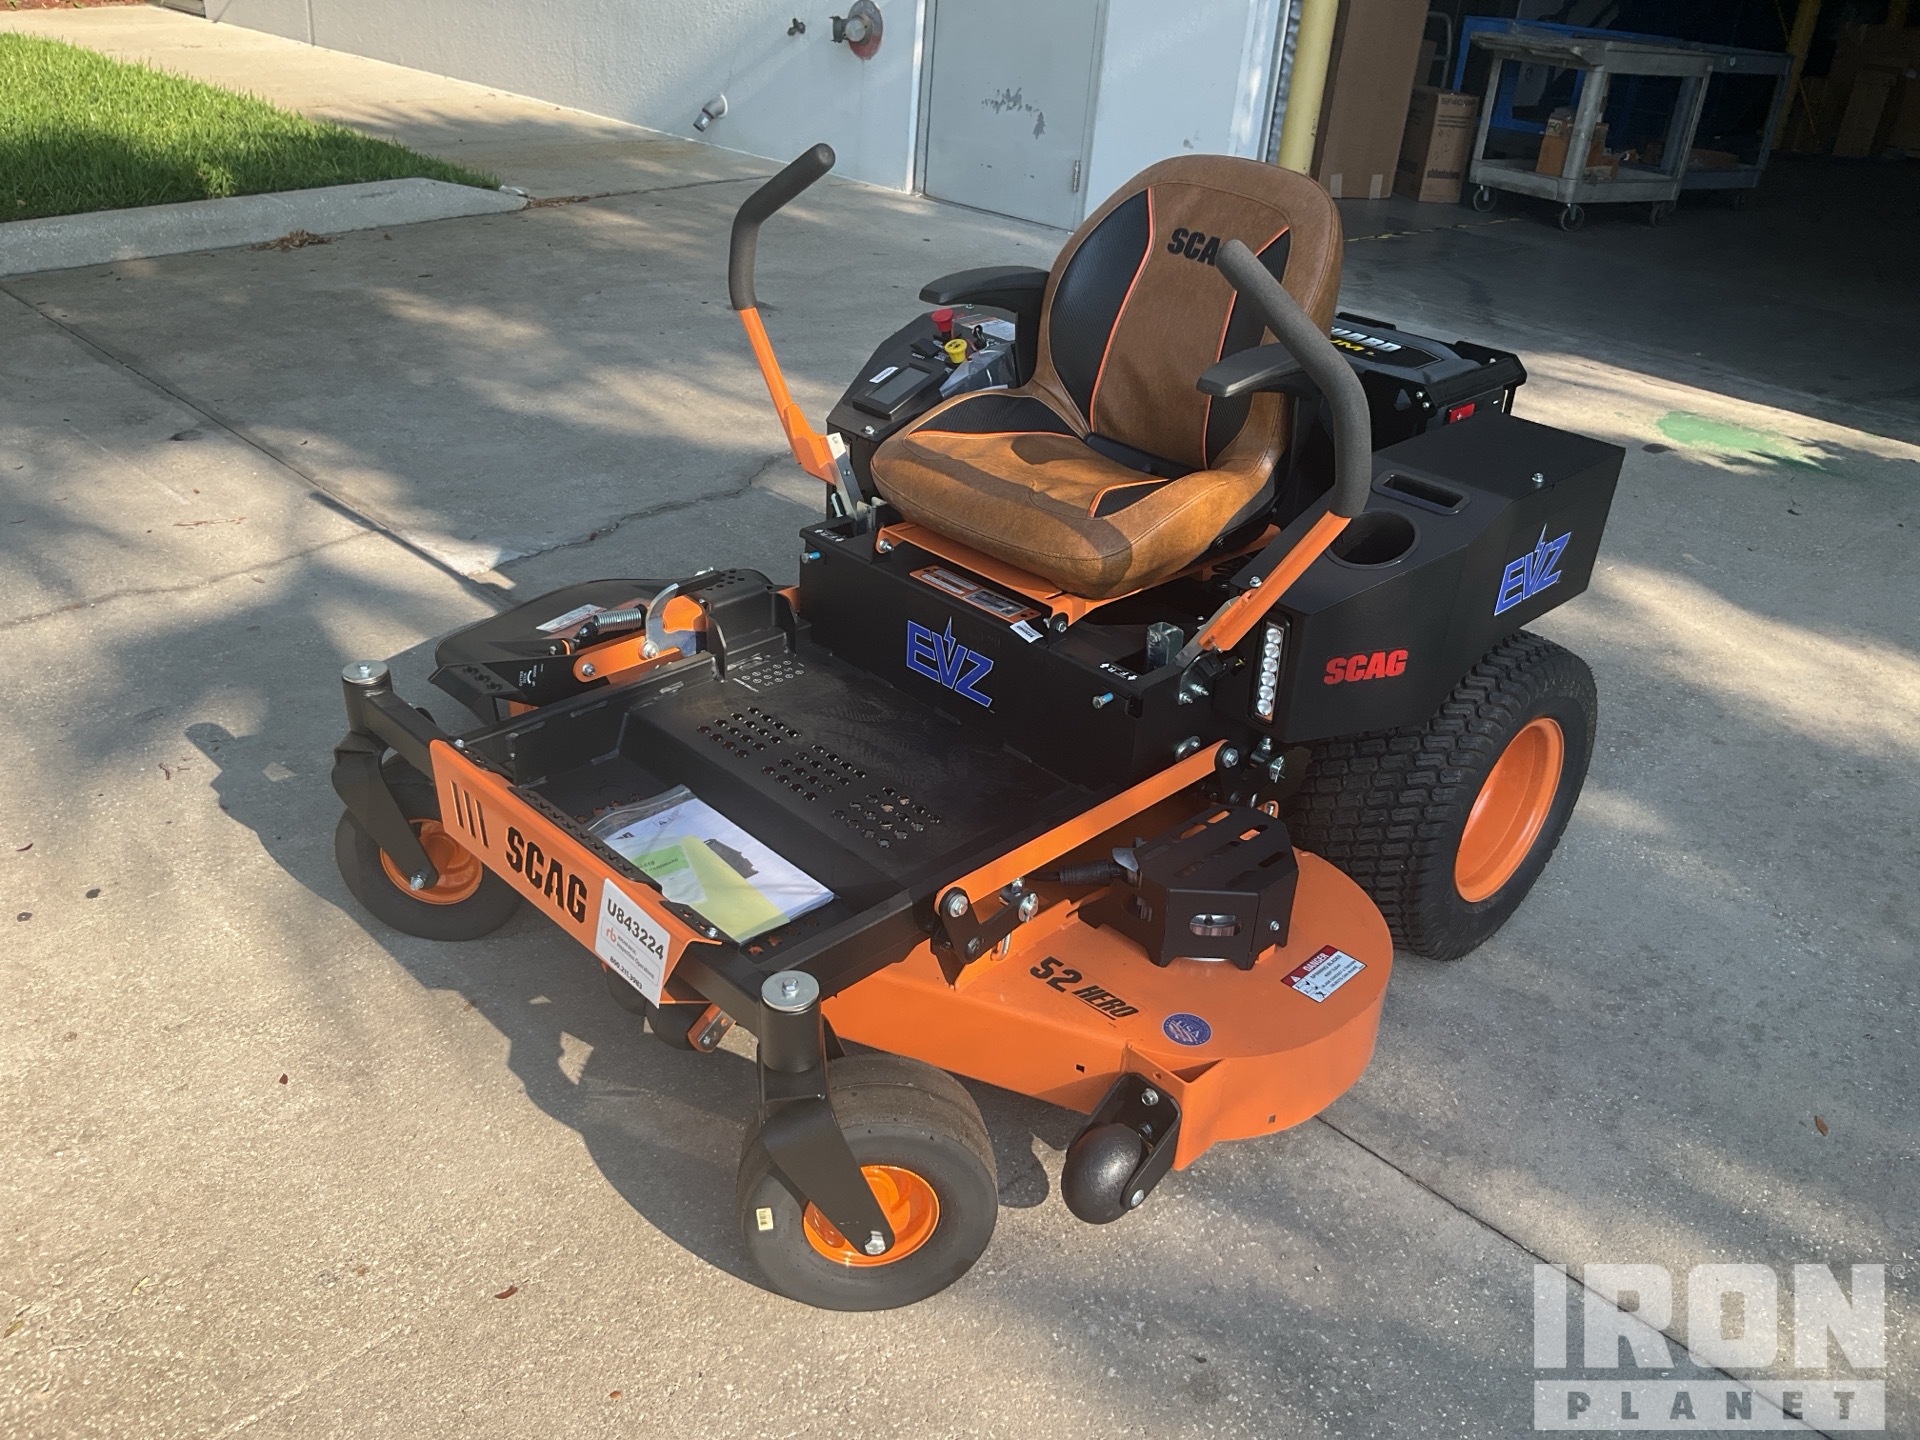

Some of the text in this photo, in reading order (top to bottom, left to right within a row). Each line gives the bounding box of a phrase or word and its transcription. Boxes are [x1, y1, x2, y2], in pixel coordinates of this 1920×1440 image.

[1167, 227, 1221, 267] SCA
[1331, 327, 1402, 353] UARD
[1494, 526, 1571, 616] EVZ
[907, 617, 994, 708] EVZ
[1323, 648, 1409, 685] SCAG
[506, 826, 587, 924] SCAG
[607, 898, 664, 960] U843224
[1029, 955, 1140, 1019] 52 HERO
[1302, 952, 1330, 972] DANGER
[1175, 1019, 1200, 1038] USA
